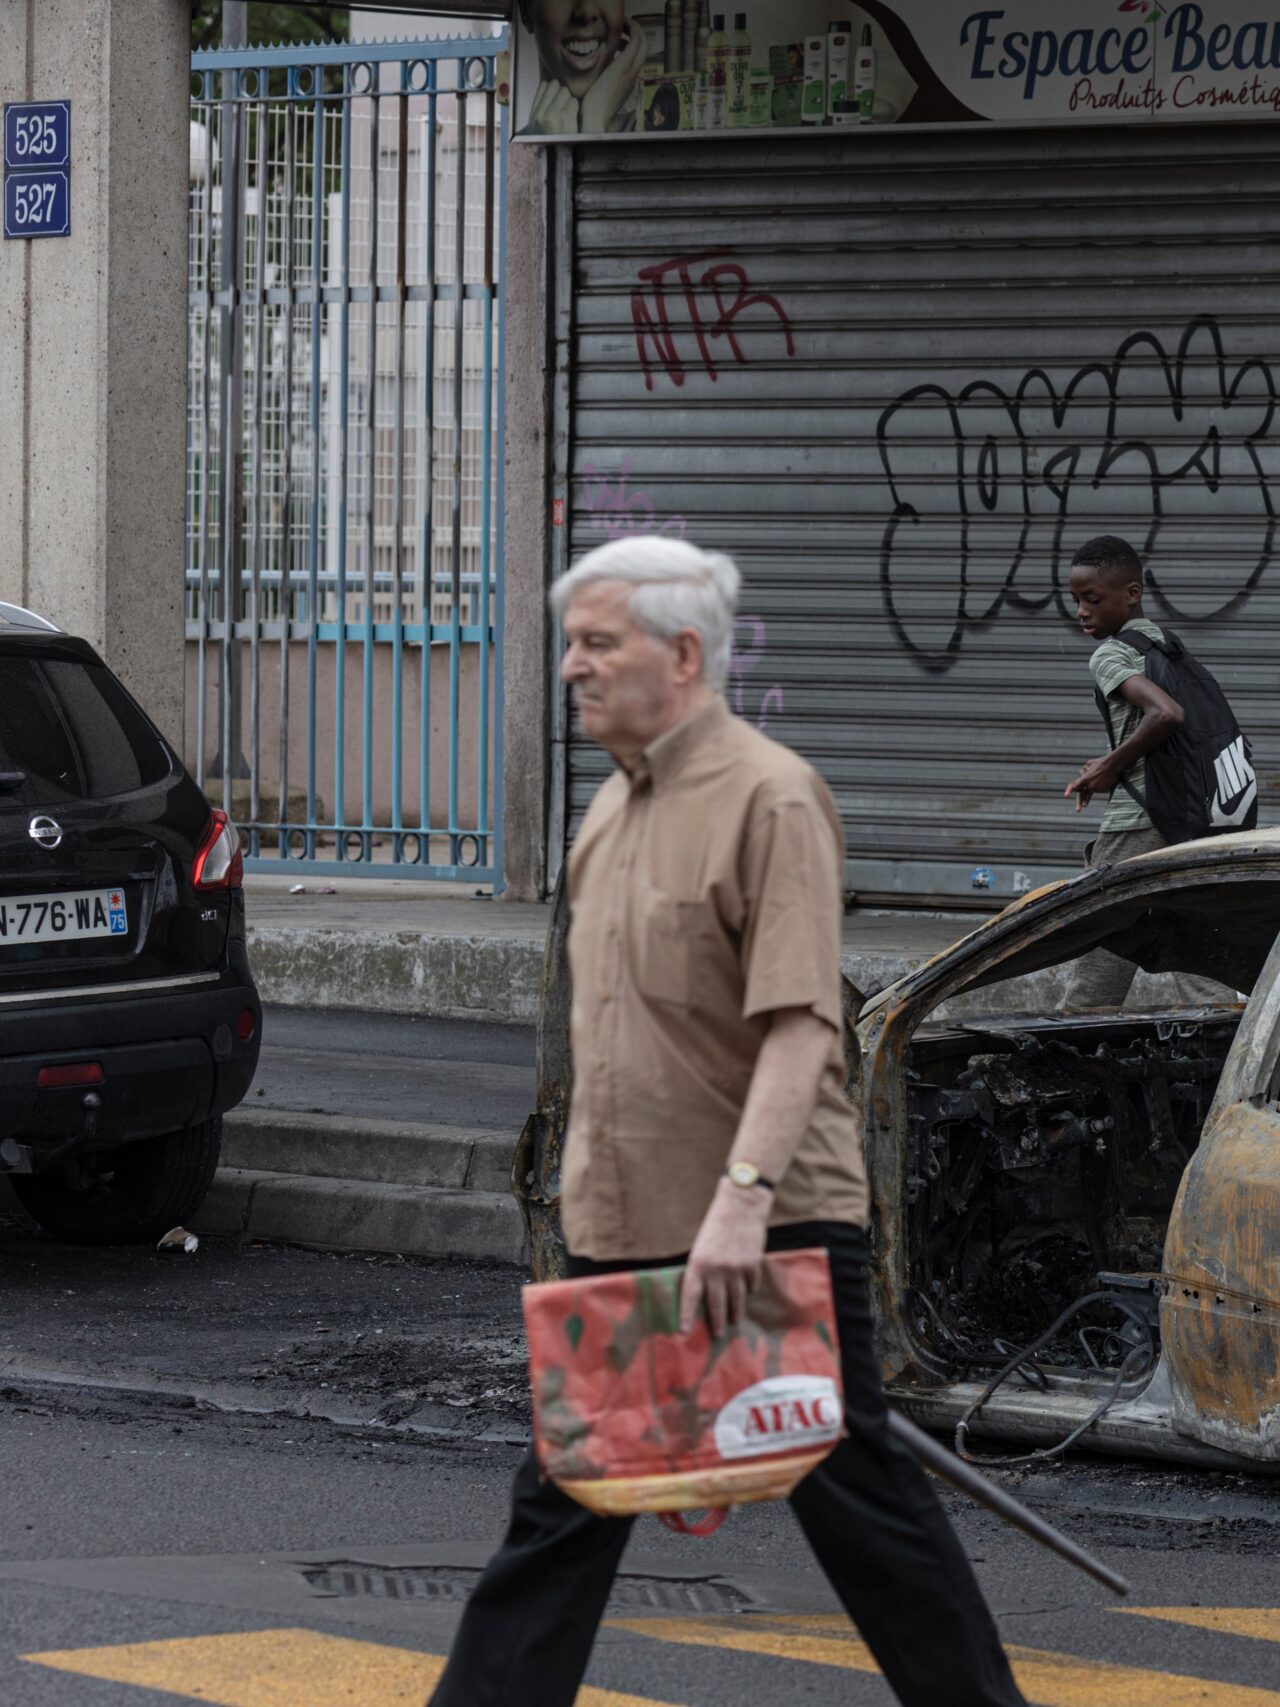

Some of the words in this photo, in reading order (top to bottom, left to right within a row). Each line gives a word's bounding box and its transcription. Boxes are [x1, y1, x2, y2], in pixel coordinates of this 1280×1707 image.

[959, 10, 1153, 100] Espace
[1068, 77, 1167, 111] Produits
[15, 115, 57, 155] 525
[15, 183, 57, 224] 527
[111, 914, 125, 930] 75
[743, 1396, 837, 1438] ATAC
